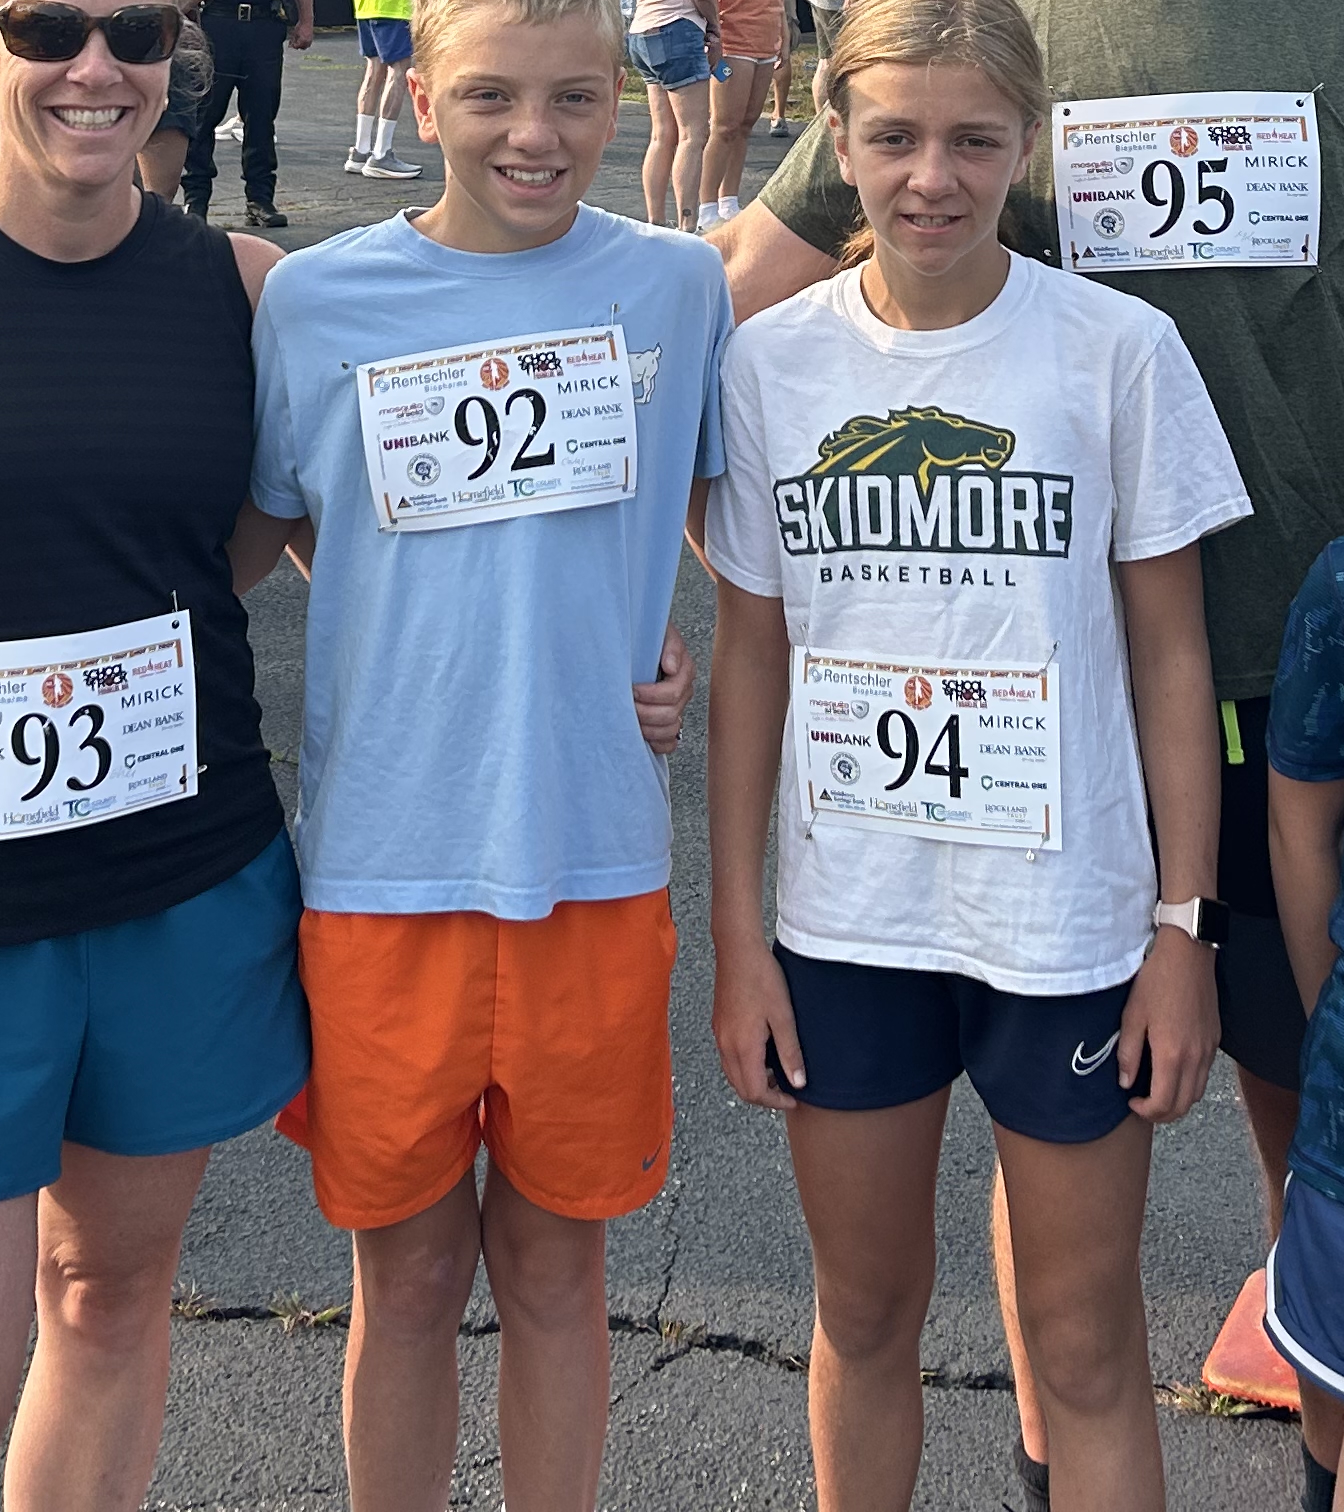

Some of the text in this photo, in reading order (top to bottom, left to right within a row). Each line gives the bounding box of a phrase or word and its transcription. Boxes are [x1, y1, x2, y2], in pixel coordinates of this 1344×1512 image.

[1084, 130, 1157, 145] Rentschler
[1244, 155, 1309, 168] MIRICK
[1072, 189, 1136, 202] UNIBANK
[1245, 182, 1309, 192] DEAN BANK
[1141, 157, 1235, 238] 95
[1261, 214, 1294, 222] CENTRAL
[391, 367, 466, 389] Rentschler
[557, 374, 620, 395] MIRICK
[560, 402, 624, 420] DEAN BANK
[382, 429, 451, 451] UNIBANK
[454, 387, 555, 481] 92
[579, 438, 612, 449] CENTRAL
[774, 474, 1073, 556] SKIDMORE
[820, 563, 1017, 587] BASKETBALL
[823, 668, 892, 688] Rentschler
[121, 682, 184, 710] MIRICK
[122, 711, 185, 735] DEAN BANK
[979, 714, 1047, 731] MIRICK
[810, 729, 872, 748] UNIBANK
[11, 703, 112, 802] 93
[137, 748, 169, 763] CENTRAL
[876, 708, 969, 799] 94
[979, 743, 1047, 757] DEAN BANK
[994, 780, 1030, 789] CENTRAL
